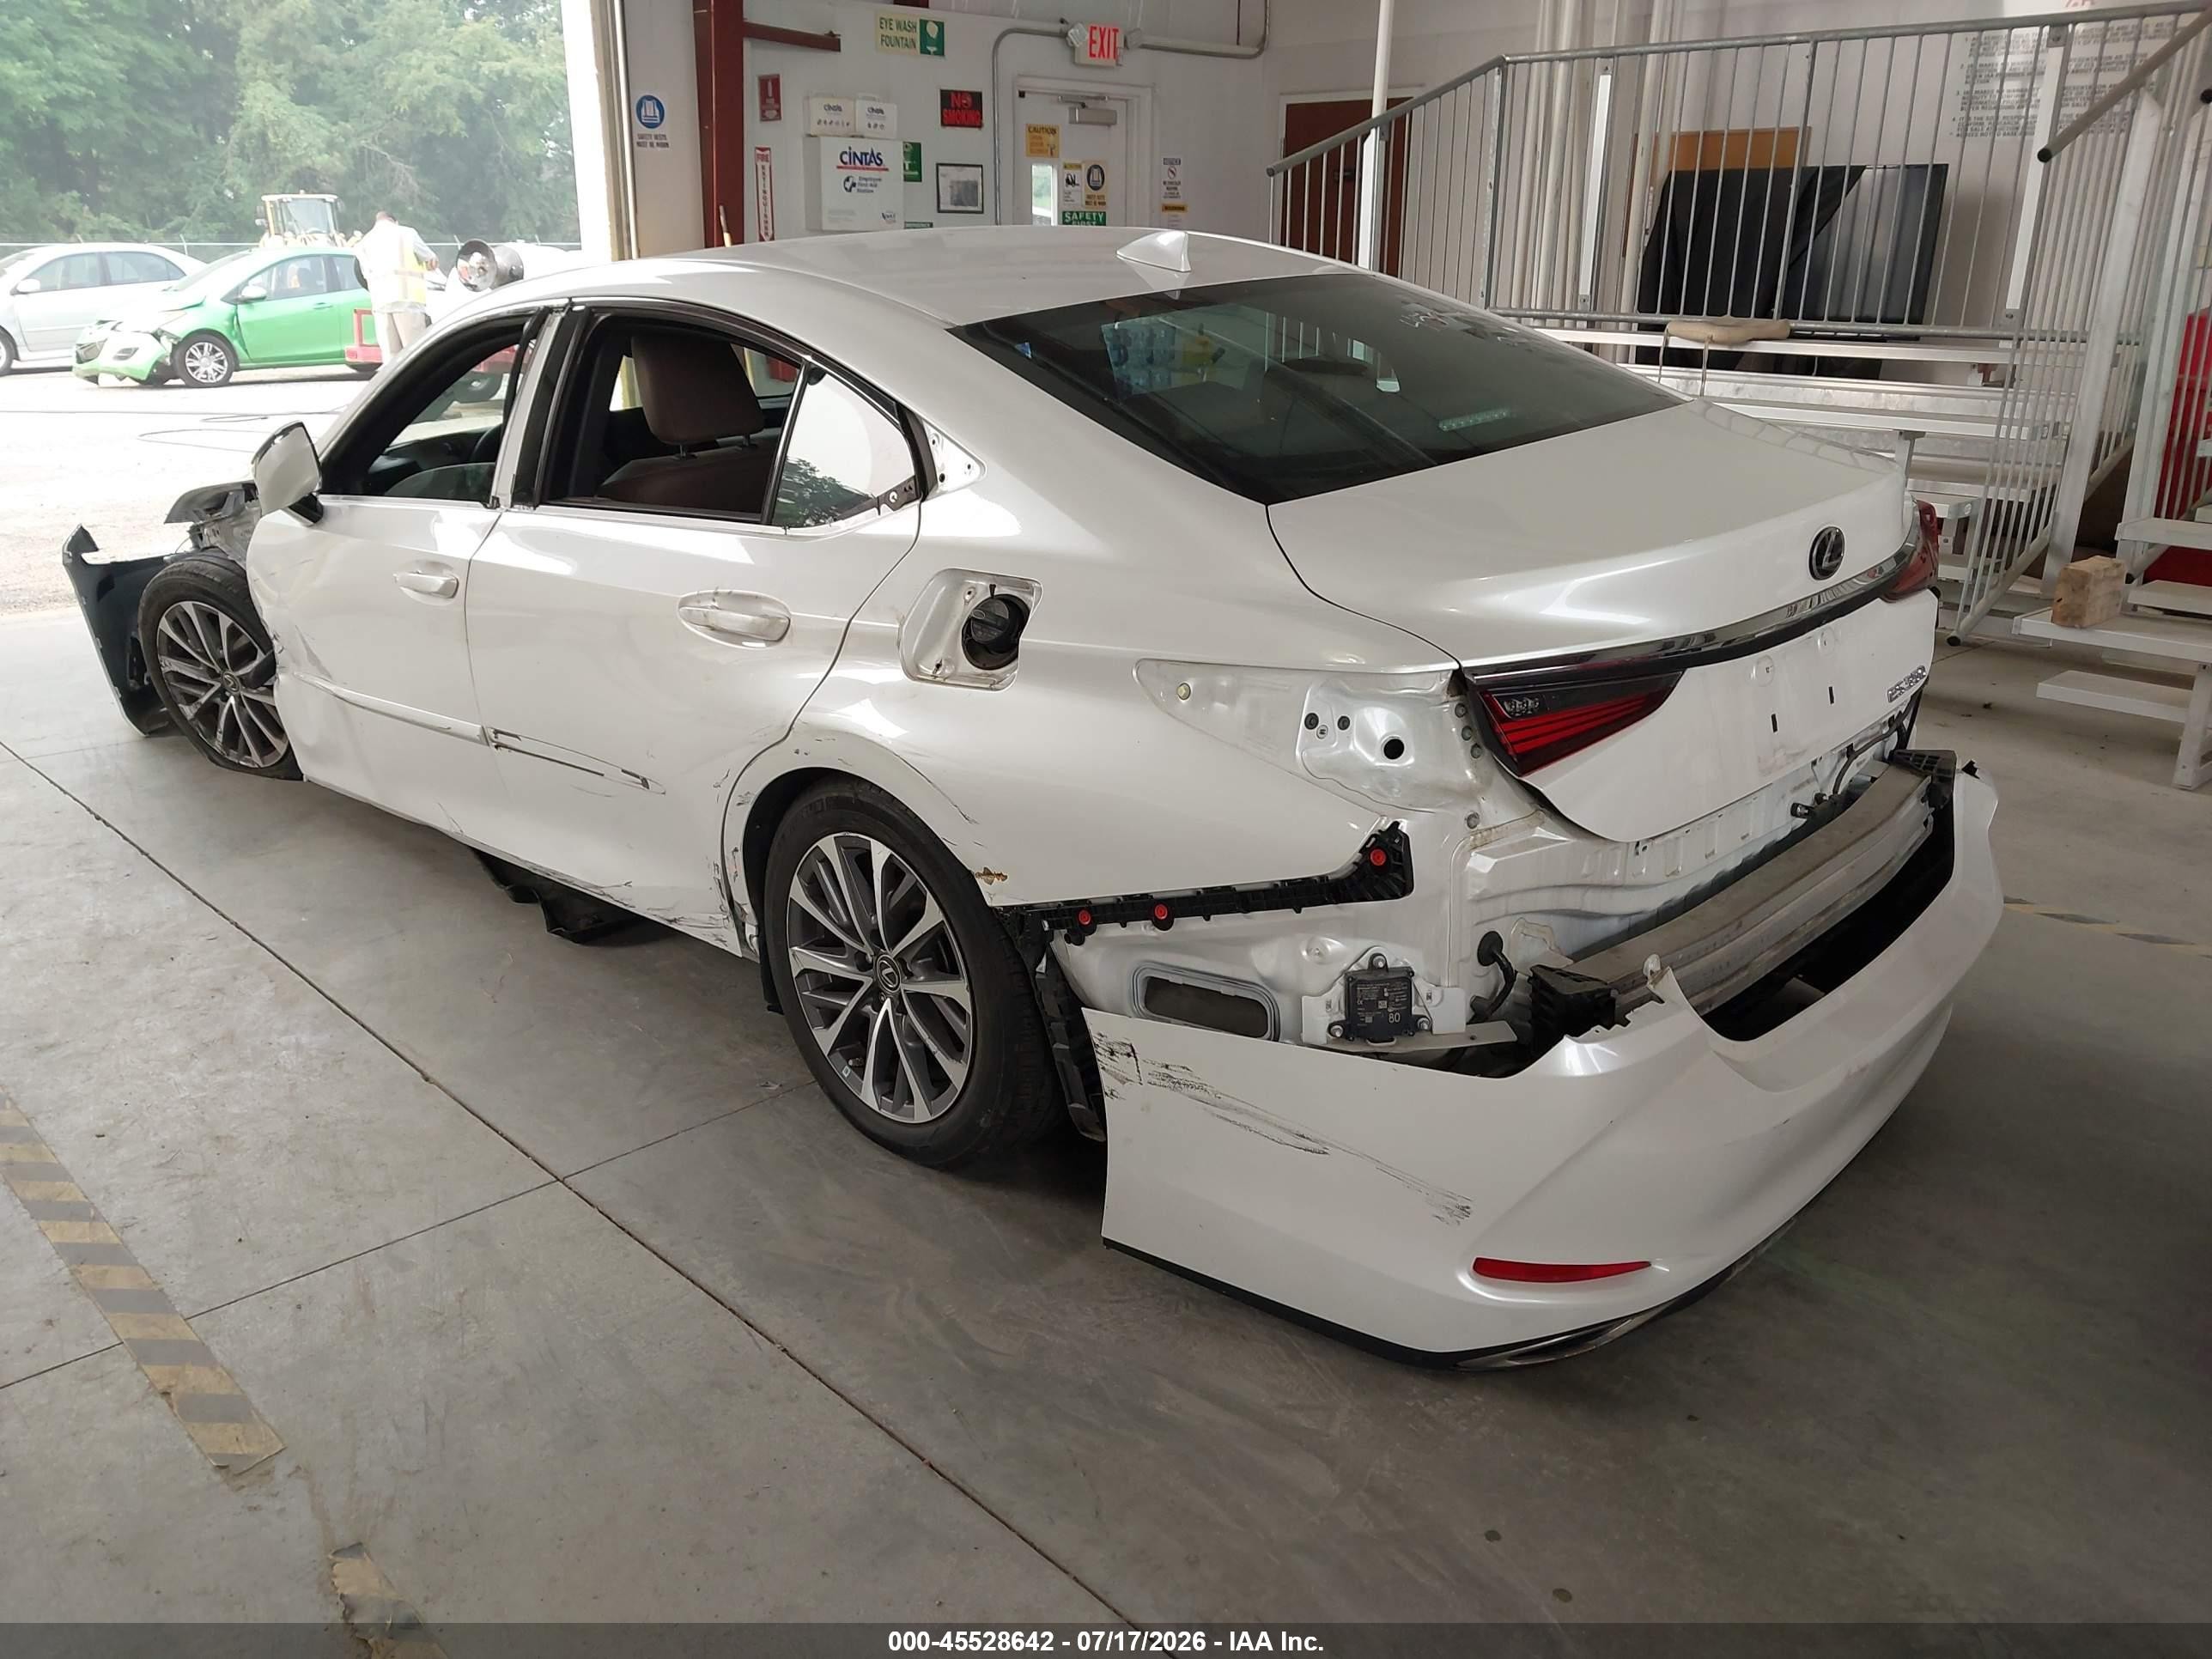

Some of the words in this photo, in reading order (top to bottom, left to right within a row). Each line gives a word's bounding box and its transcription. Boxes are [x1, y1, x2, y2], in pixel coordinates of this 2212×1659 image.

[879, 17, 894, 31] EYE
[895, 20, 917, 33] WASH
[880, 33, 916, 48] FOUNTAIN
[1089, 26, 1119, 59] EXIT
[951, 92, 971, 108] NO
[943, 109, 981, 125] SMOKING
[1064, 212, 1104, 223] SAFETY
[1389, 1012, 1401, 1024] 80
